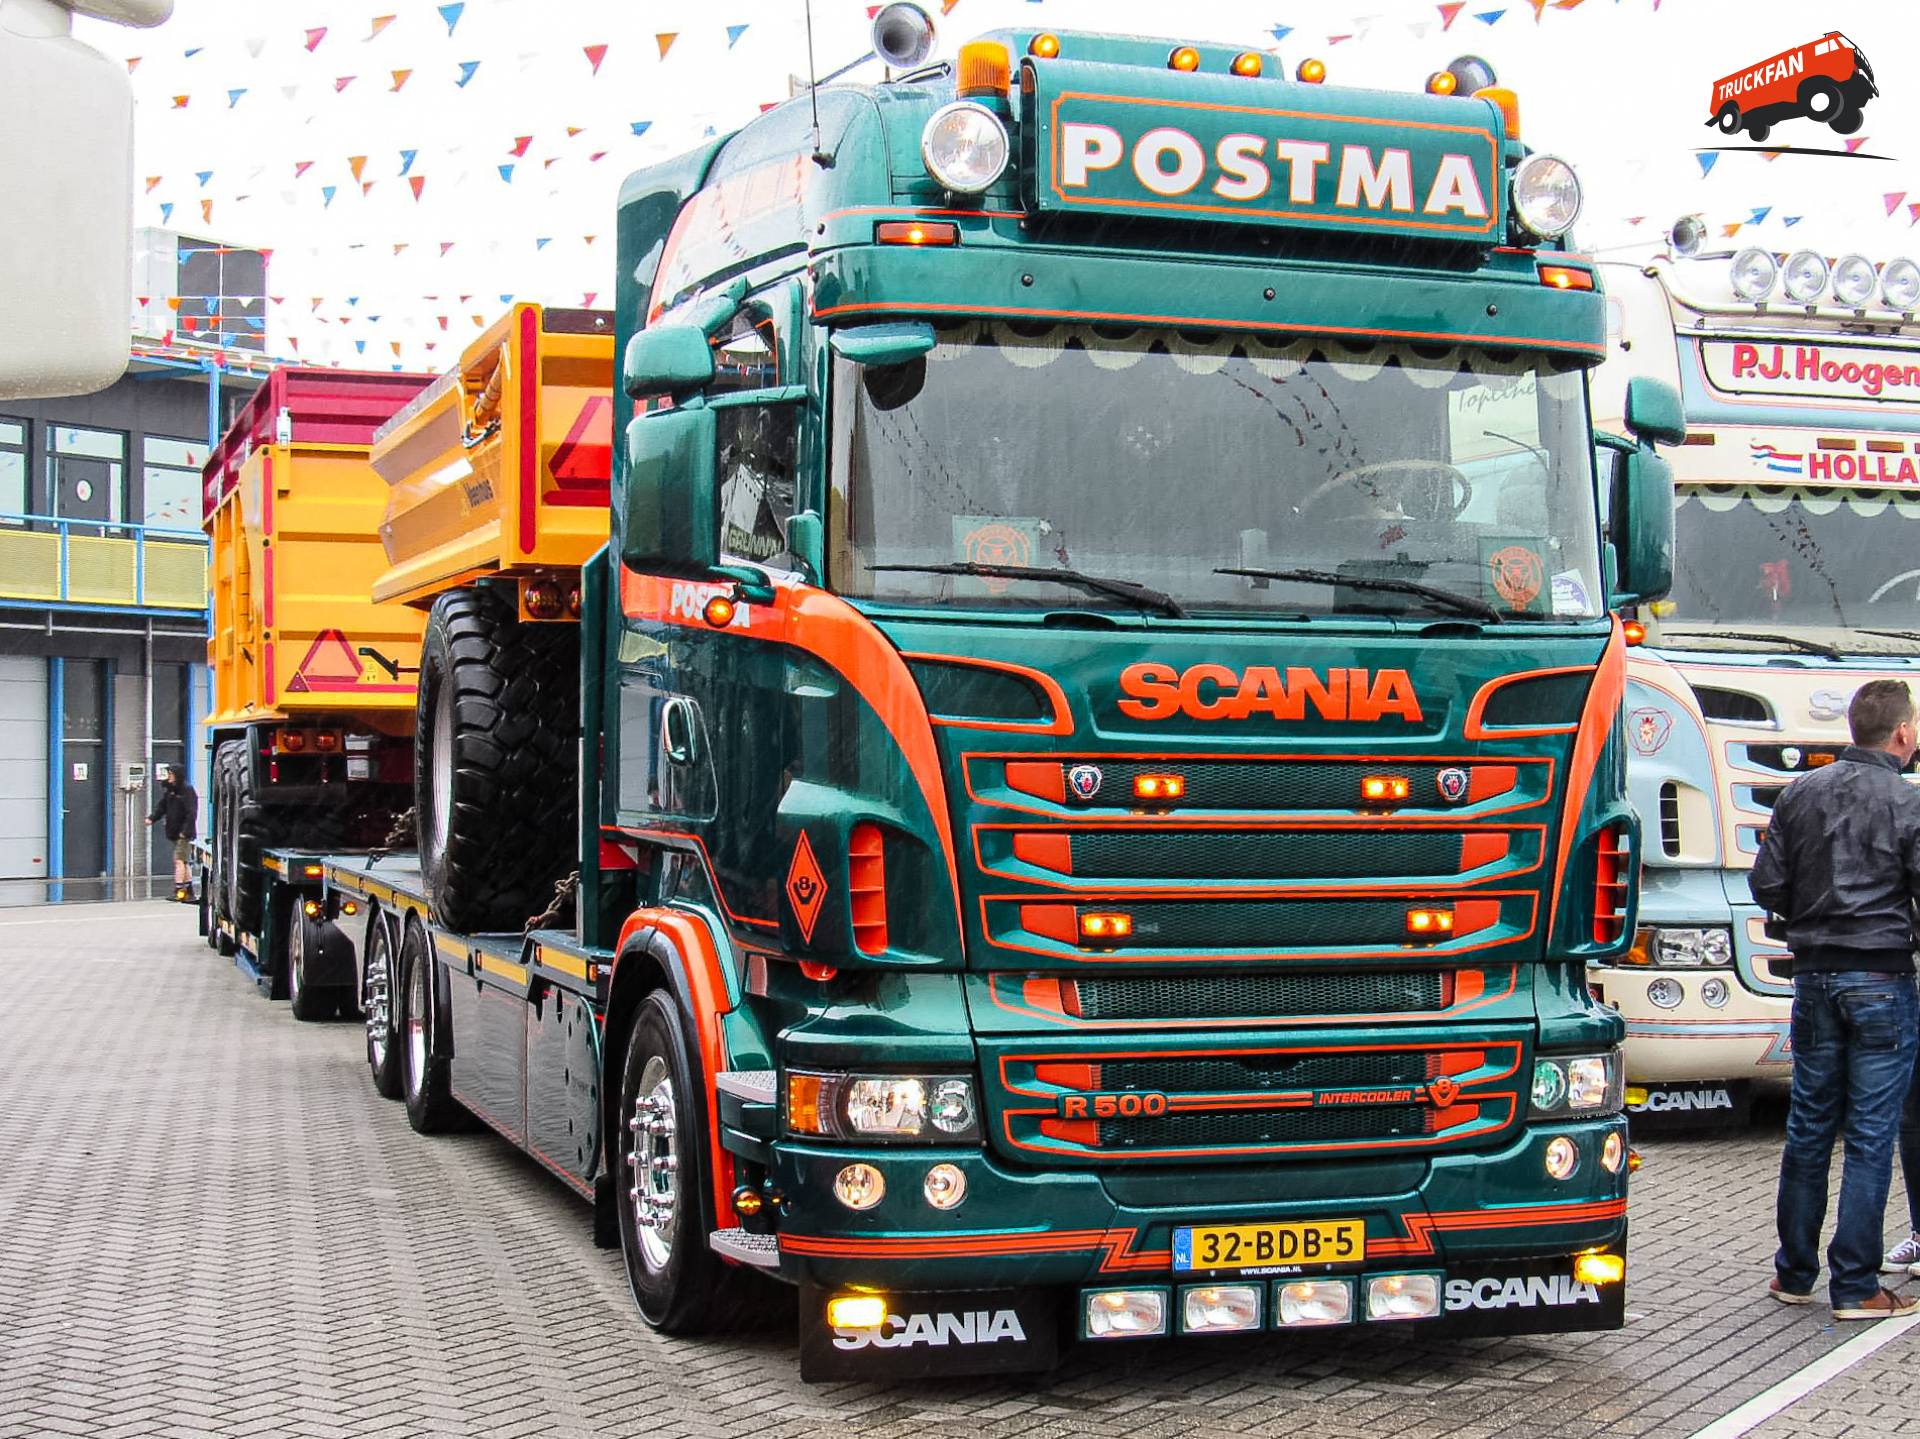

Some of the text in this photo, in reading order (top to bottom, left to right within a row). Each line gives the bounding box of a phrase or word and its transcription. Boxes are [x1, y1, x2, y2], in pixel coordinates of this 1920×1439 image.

[1062, 122, 1490, 218] POSTMA
[1732, 344, 1791, 379] P.J.
[1808, 452, 1920, 484] HOLLA
[671, 583, 750, 628] POSA
[1117, 662, 1424, 722] SCANIA
[1064, 1093, 1166, 1118] R 500
[1318, 1089, 1412, 1105] INTERCOOLER
[1175, 1252, 1190, 1264] NL
[1201, 1226, 1354, 1263] 32-BDB-5
[1444, 1274, 1600, 1311] SCANIA
[832, 1309, 1027, 1351] SCANIA
